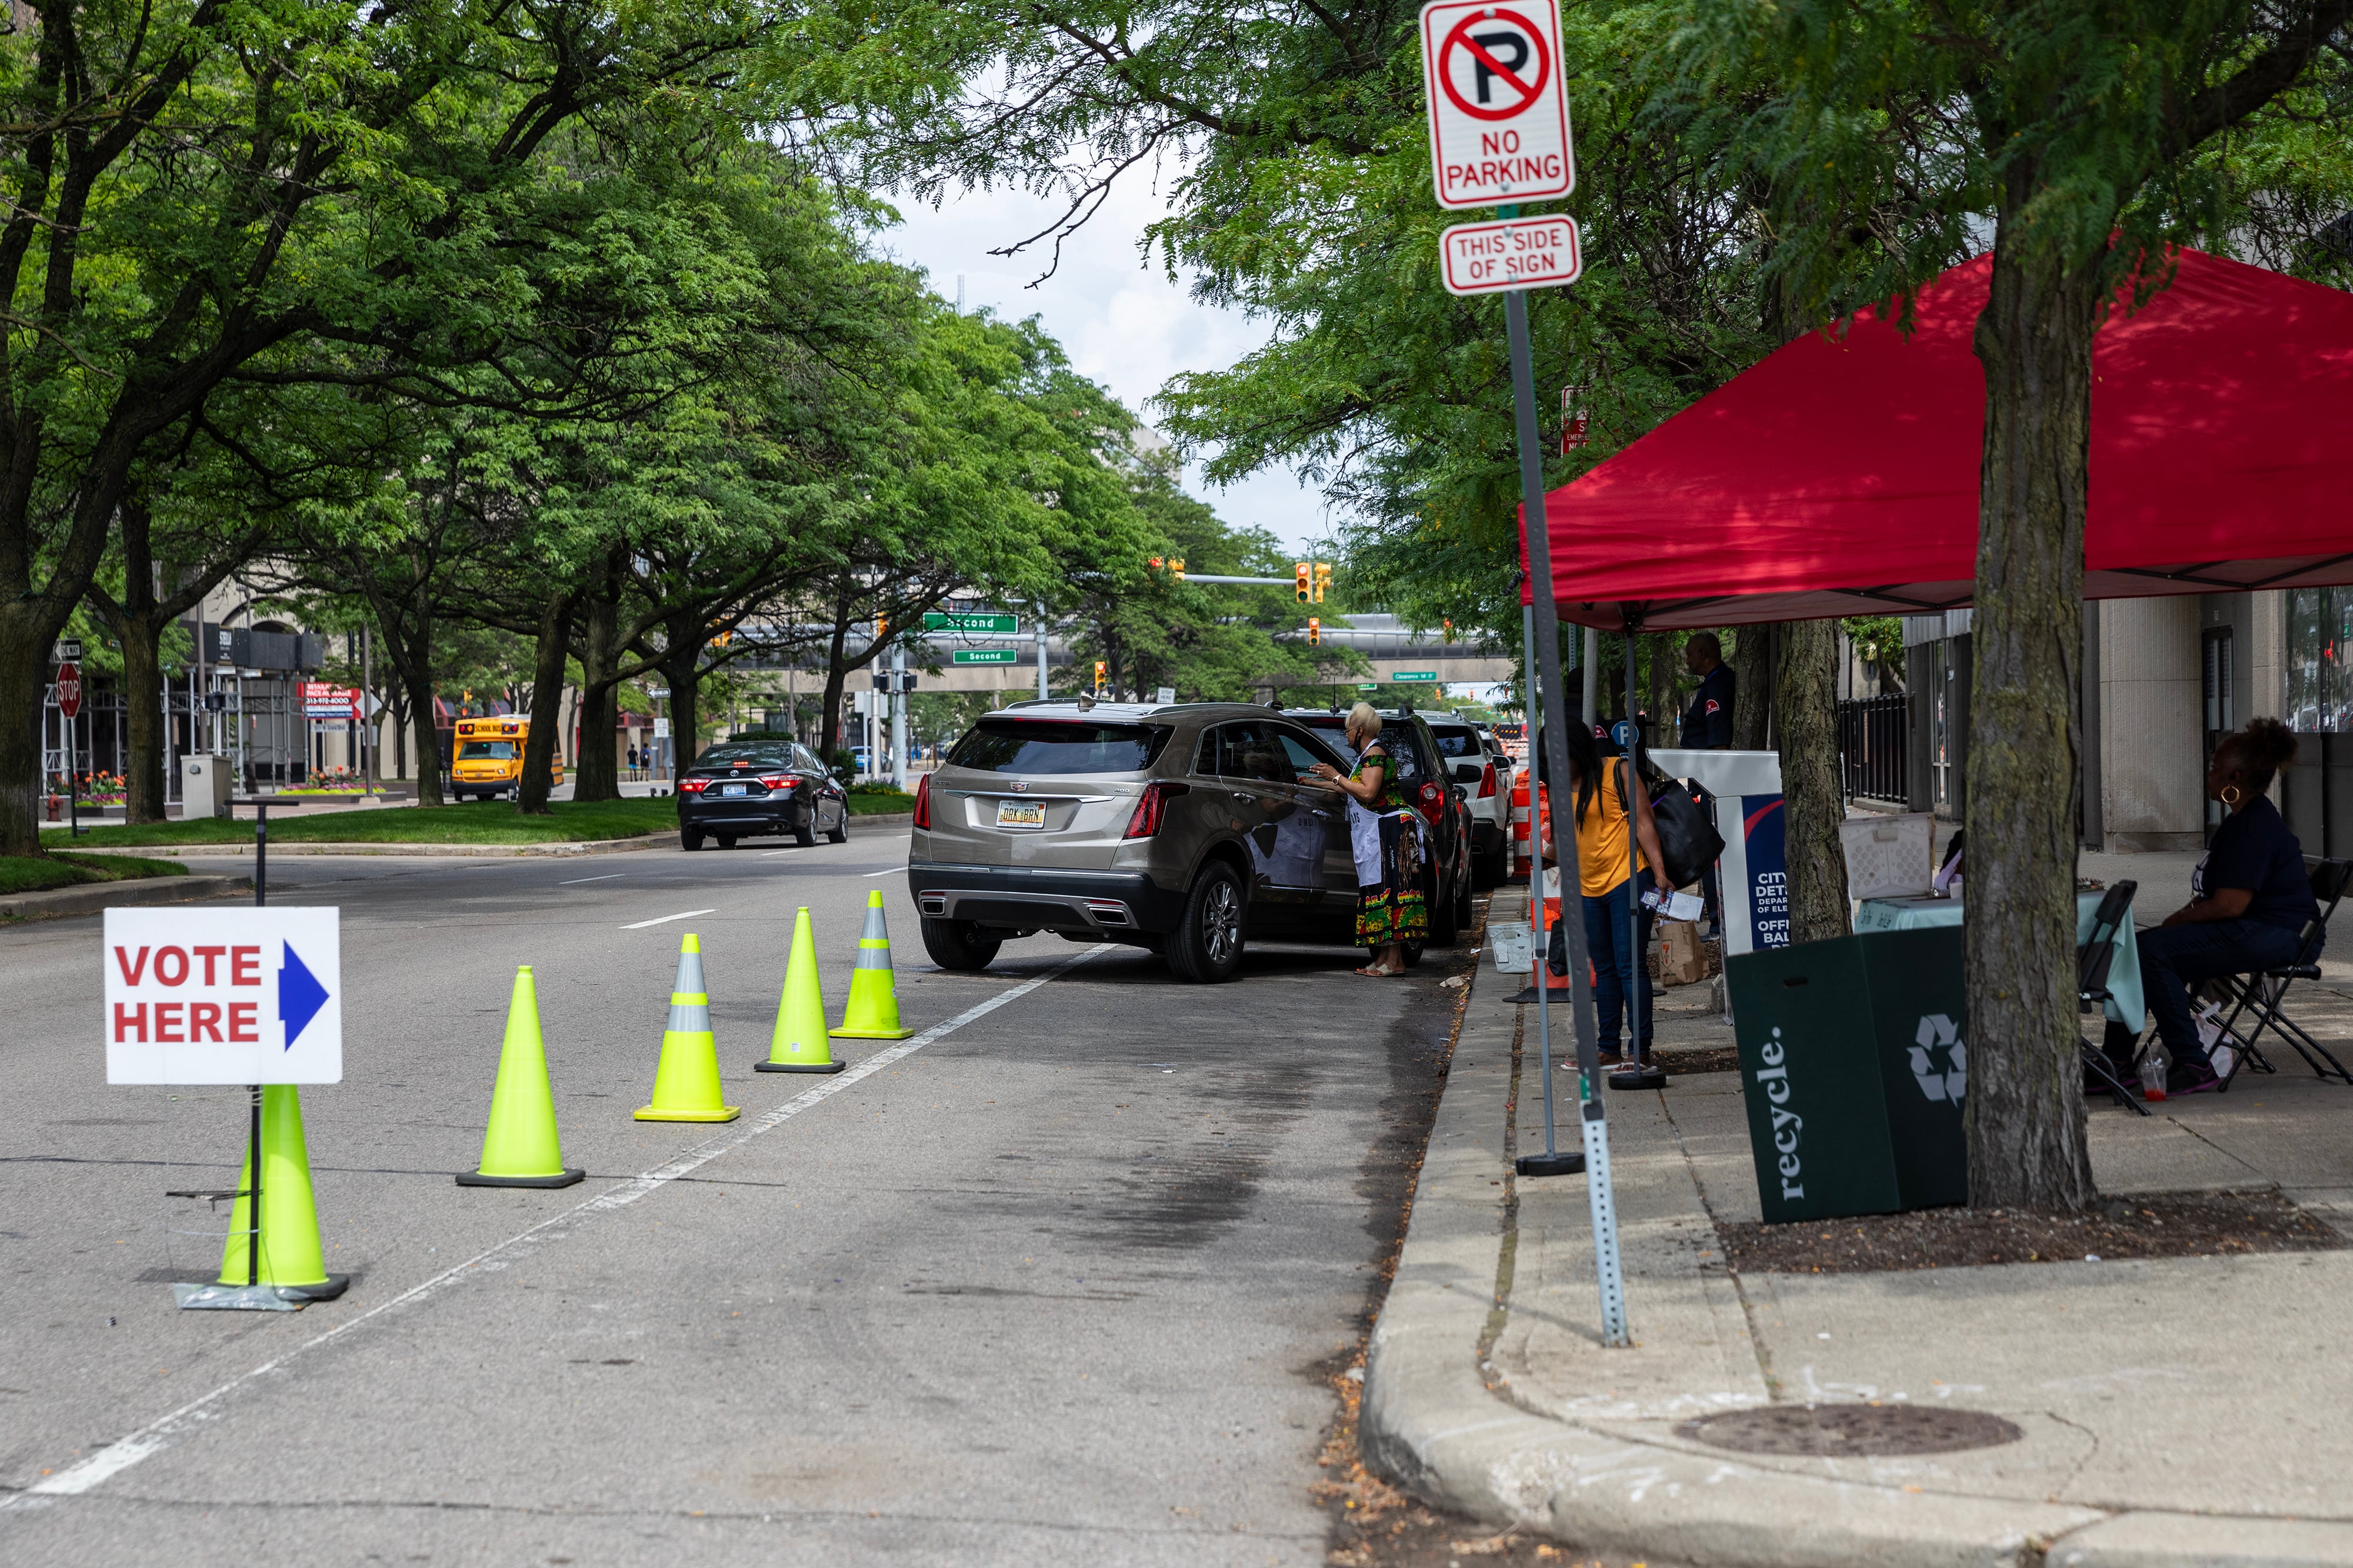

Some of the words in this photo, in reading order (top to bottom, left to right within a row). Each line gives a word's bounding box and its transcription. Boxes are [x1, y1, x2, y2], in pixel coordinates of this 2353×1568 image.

[1482, 129, 1519, 156] NO
[1448, 155, 1560, 189] PARKING
[1458, 235, 1505, 258] THIS
[1512, 228, 1563, 249] SIDE
[1470, 259, 1496, 279] OF
[1506, 253, 1556, 274] SIGN
[947, 618, 994, 628] Second
[70, 646, 79, 655] WAY
[59, 680, 79, 702] STOP
[1003, 808, 1019, 820] DRK
[1024, 809, 1039, 821] BRN
[1755, 885, 1788, 897] DET
[114, 945, 261, 987] VOTE
[114, 1002, 259, 1043] HERE
[1757, 1026, 1804, 1202] recycle.
